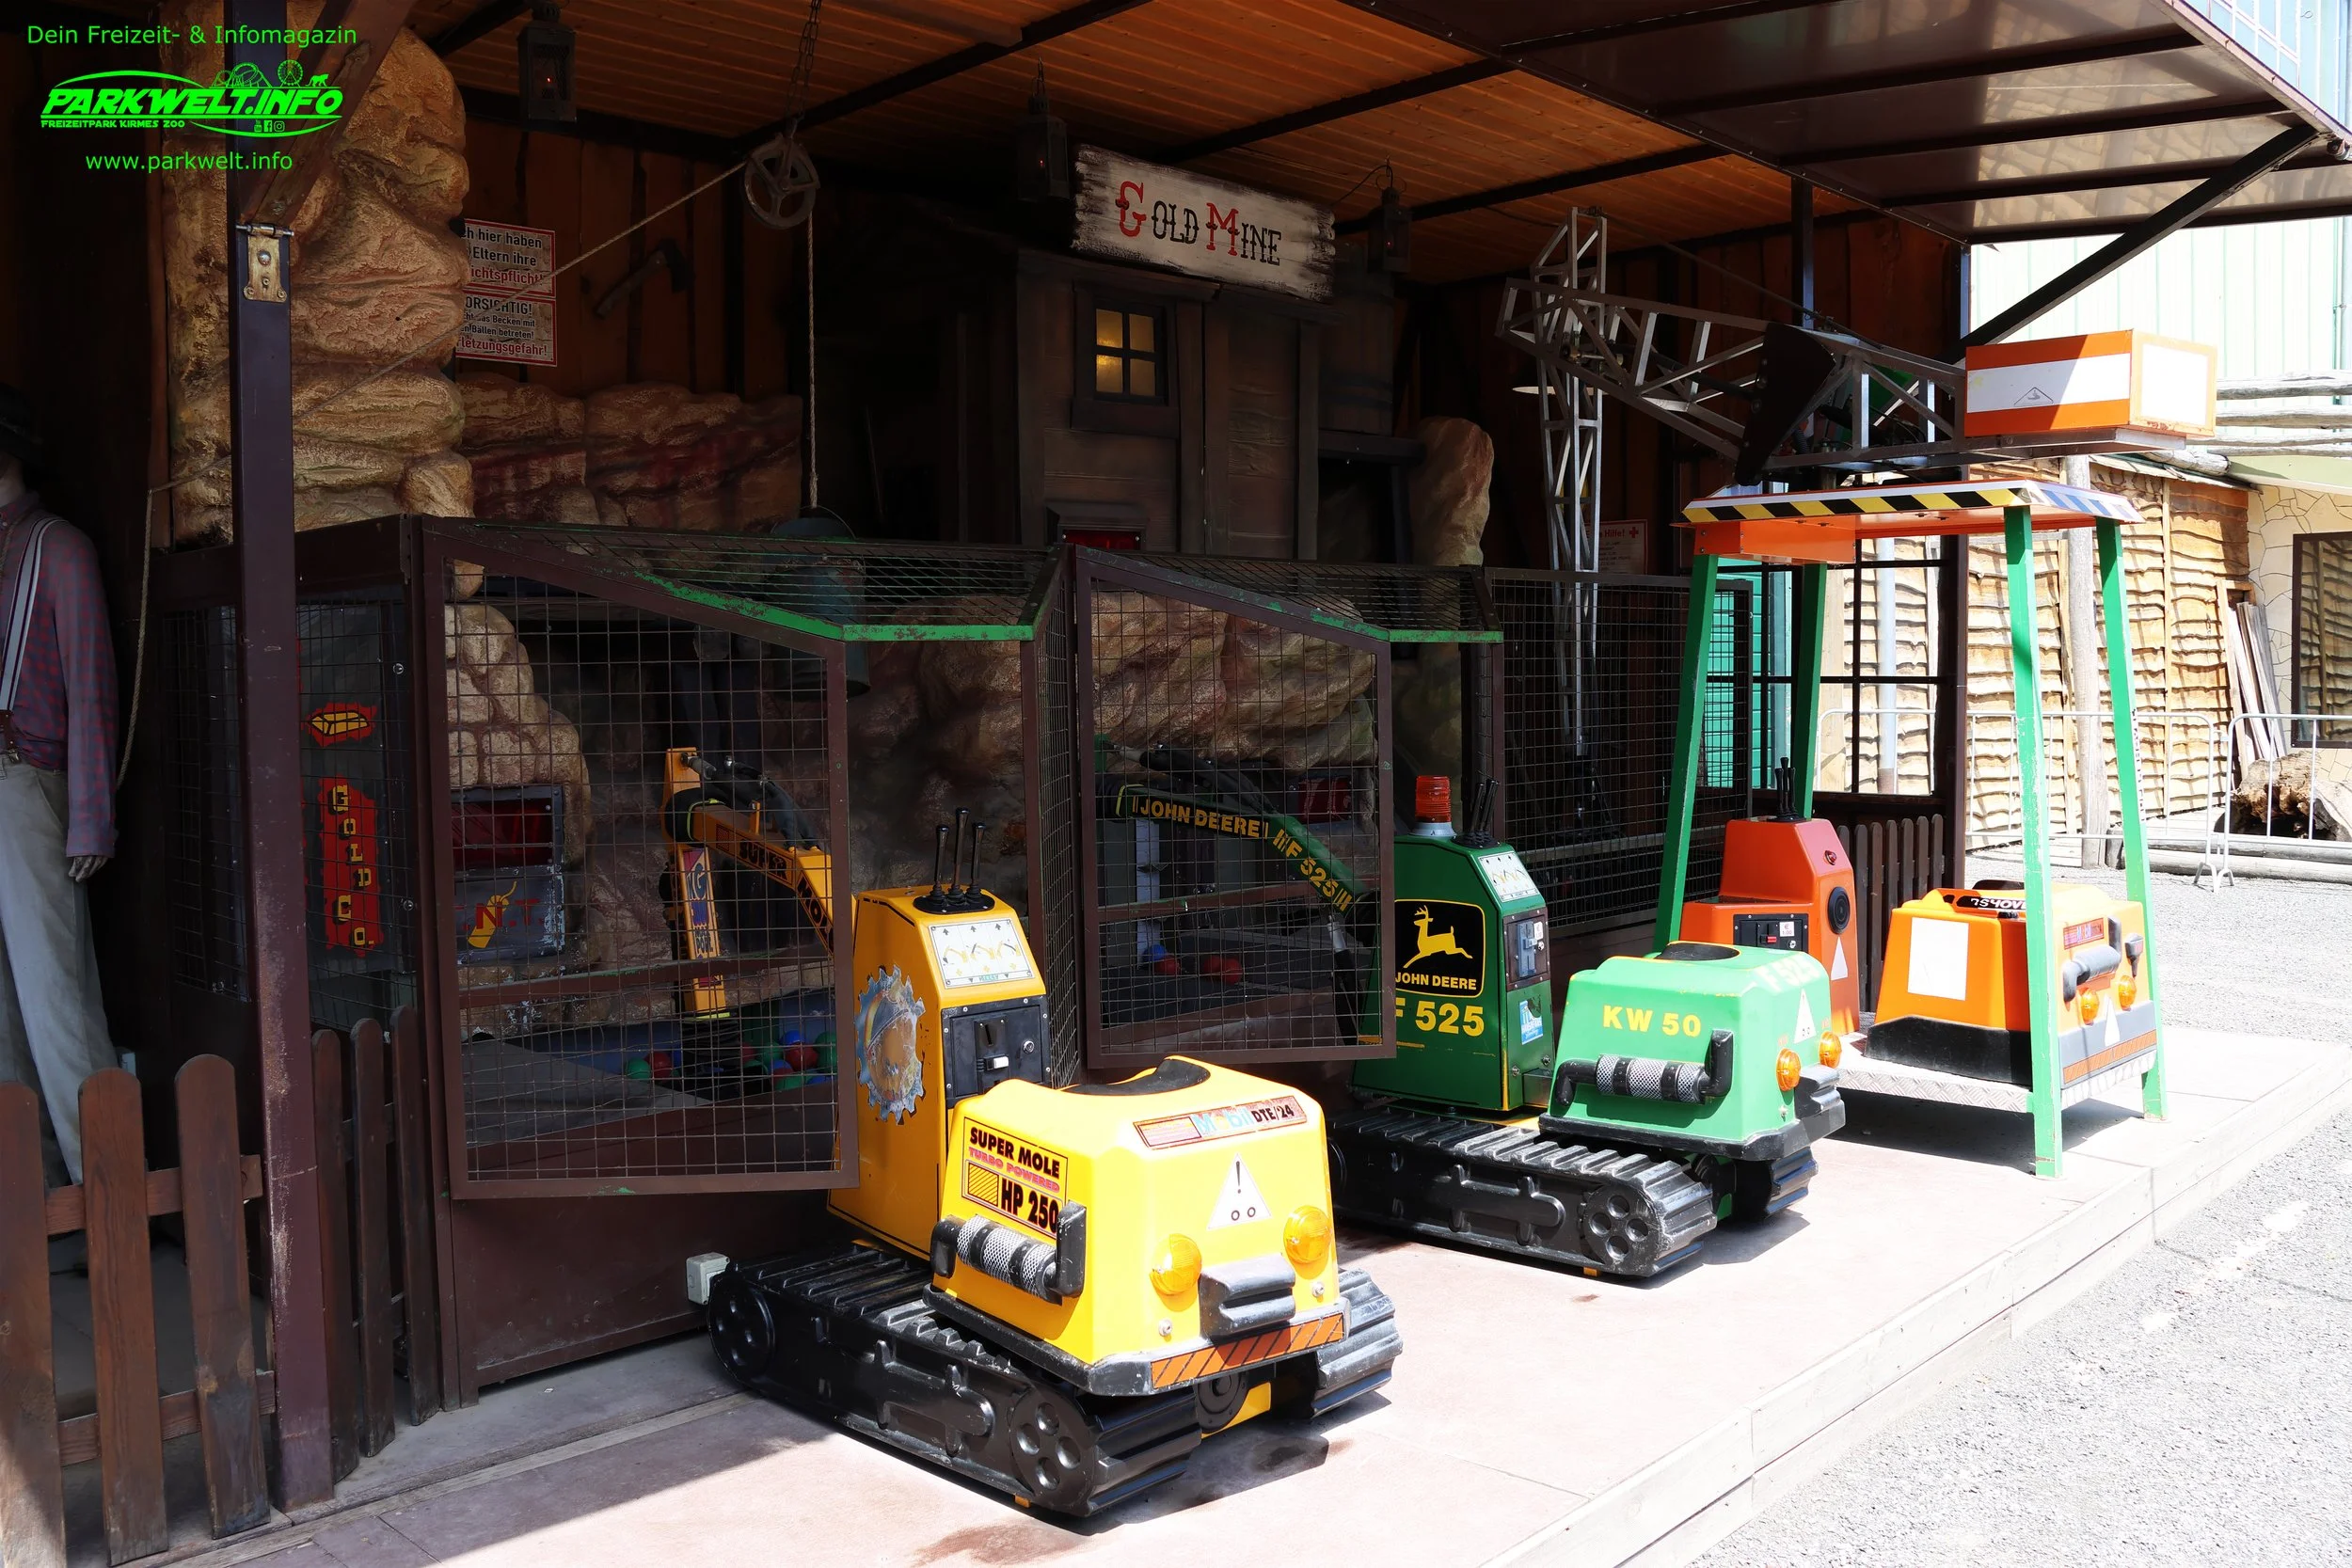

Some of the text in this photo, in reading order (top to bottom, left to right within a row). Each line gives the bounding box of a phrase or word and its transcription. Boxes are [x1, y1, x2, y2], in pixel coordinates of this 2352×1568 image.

[478, 229, 502, 243] hier
[505, 232, 543, 248] haben
[1115, 181, 1282, 266] GOLD MINE
[473, 246, 537, 266] Eltern ihre
[471, 325, 497, 336] Bällen
[498, 328, 534, 340] betreten!
[492, 315, 521, 326] Becken
[522, 318, 535, 327] mit
[1140, 799, 1261, 837] JOHN DEERE
[1395, 972, 1477, 990] JOHN DEERE
[1415, 1001, 1485, 1037] 525
[1602, 1005, 1701, 1037] KW 50
[968, 1146, 1060, 1193] TURBO POWERED
[970, 1127, 1060, 1180] SUPER MOLE
[1001, 1177, 1059, 1233] HP 250
